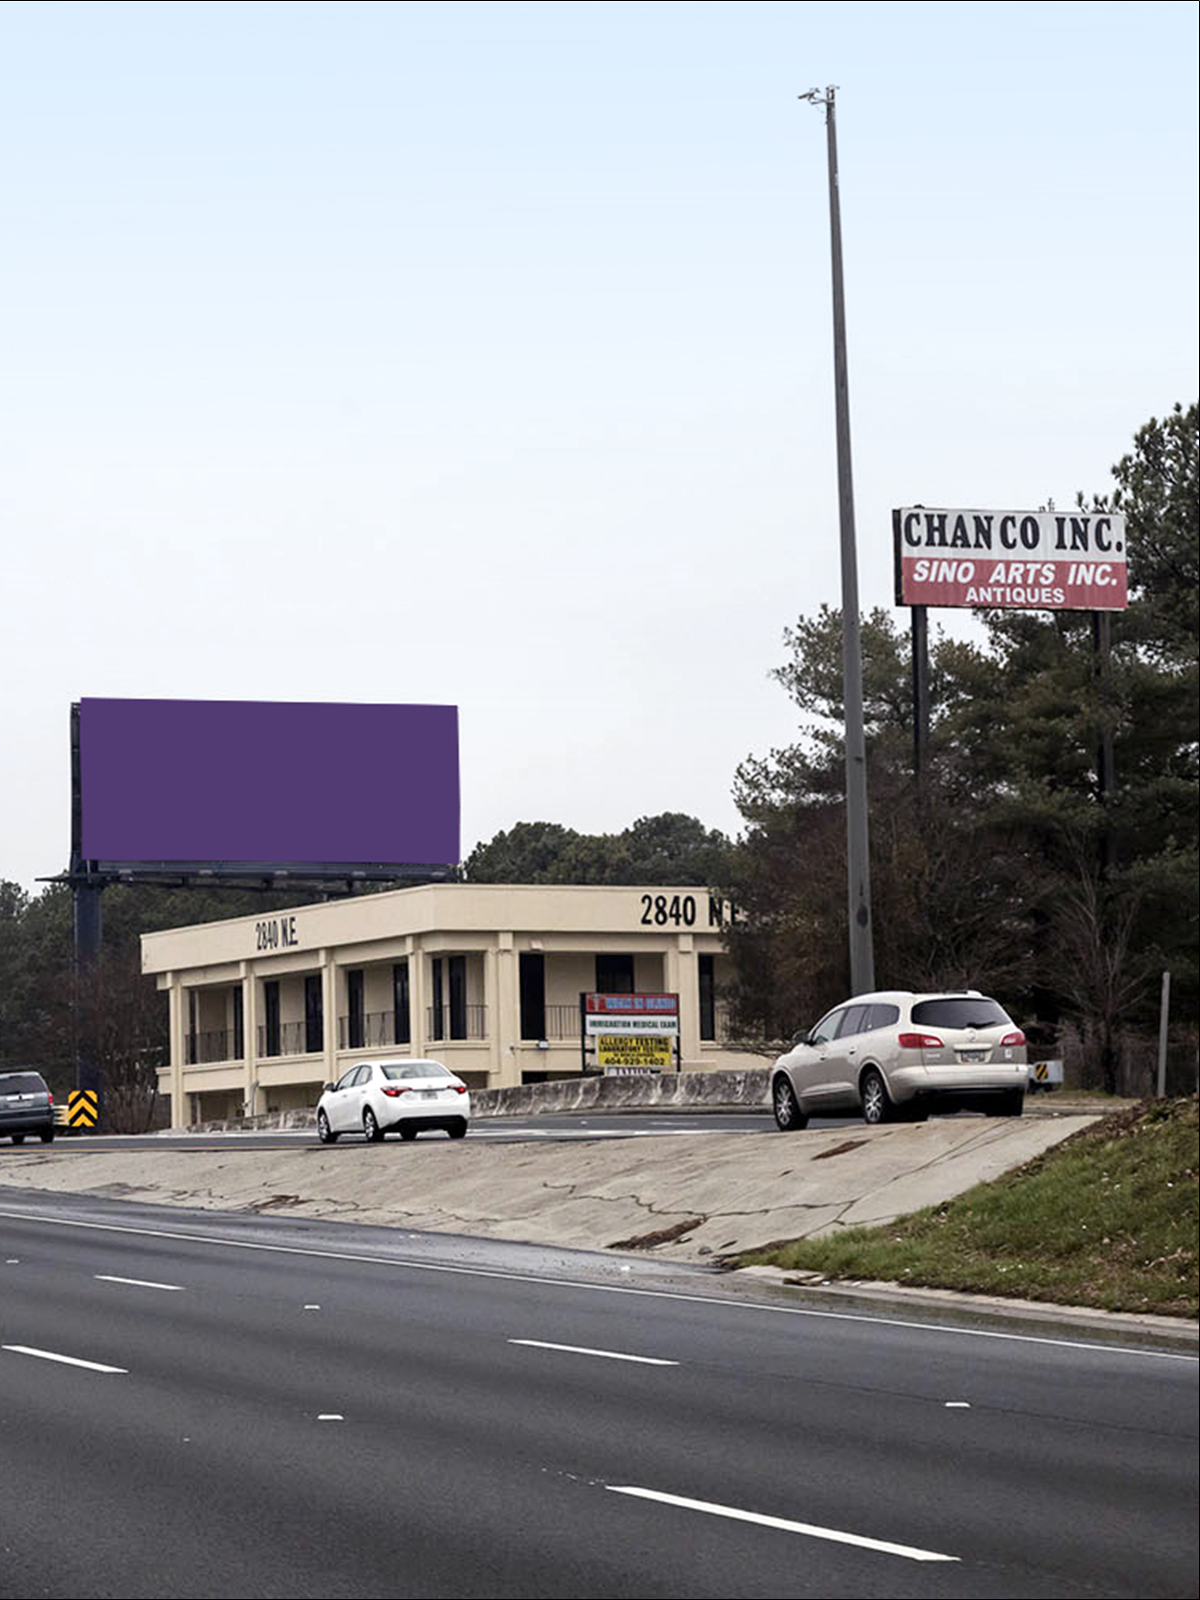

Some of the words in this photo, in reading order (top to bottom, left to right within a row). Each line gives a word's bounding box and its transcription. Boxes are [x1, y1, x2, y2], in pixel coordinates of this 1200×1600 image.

[1055, 517, 1123, 552] INC.
[913, 560, 975, 583] SINO
[989, 562, 1055, 585] ARTS
[1067, 563, 1118, 586] INC.
[965, 586, 1065, 604] ANTIQUES
[641, 894, 696, 926] 2840
[255, 920, 279, 950] 2840
[633, 1020, 659, 1029] MEDICAL
[660, 1020, 677, 1029] EXAM
[601, 1037, 634, 1046] ALLERGY
[636, 1037, 669, 1046] TESTING
